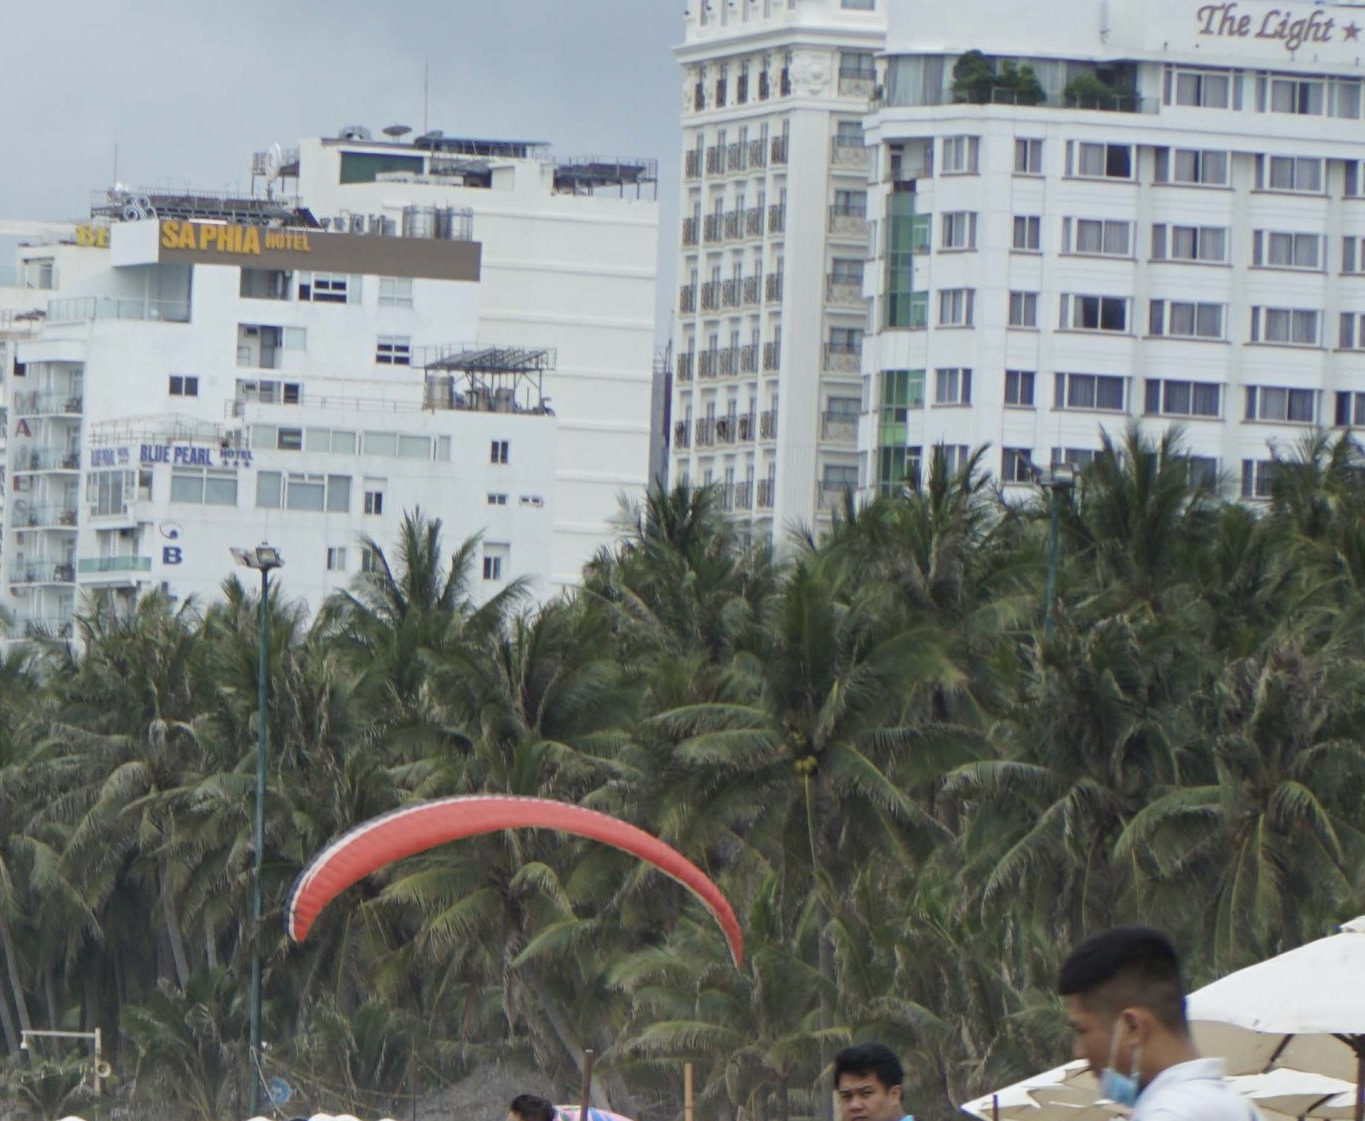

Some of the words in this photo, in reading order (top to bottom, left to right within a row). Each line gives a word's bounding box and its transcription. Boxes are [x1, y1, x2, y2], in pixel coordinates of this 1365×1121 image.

[1197, 2, 1251, 36] The
[1255, 9, 1334, 51] Light
[161, 220, 196, 249] SA
[199, 223, 261, 255] PHIA
[265, 231, 311, 251] HOTEL
[140, 443, 170, 463] BLUE
[174, 445, 214, 466] PEARL
[220, 448, 254, 461] HOTEL
